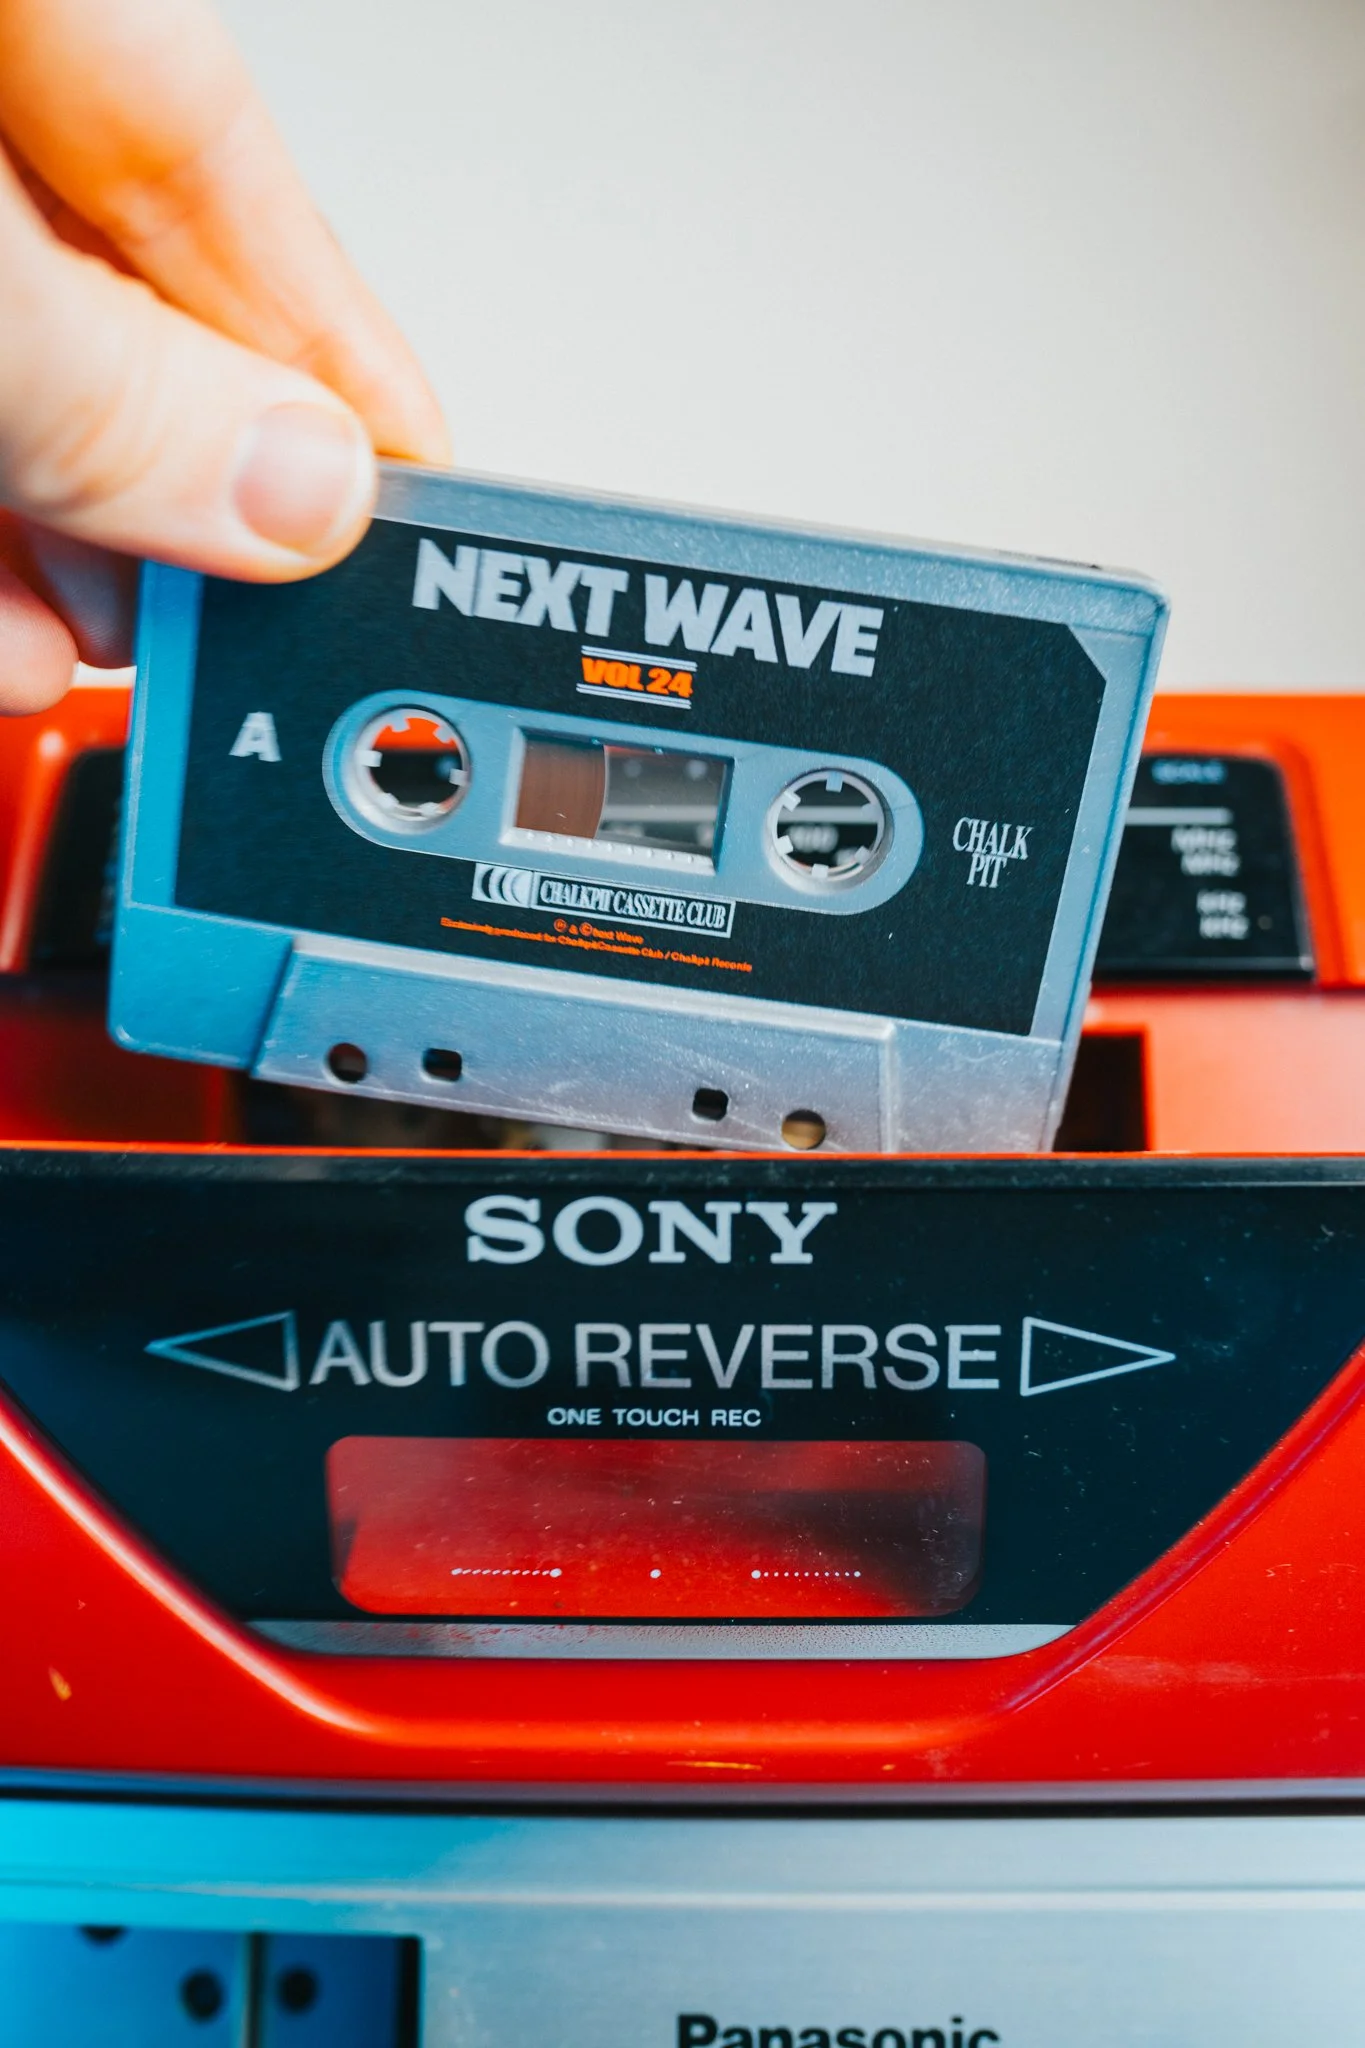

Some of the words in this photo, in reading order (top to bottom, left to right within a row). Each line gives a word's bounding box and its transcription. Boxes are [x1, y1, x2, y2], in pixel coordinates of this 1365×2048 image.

[413, 539, 629, 637] NEXT
[644, 574, 884, 677] WAVE
[581, 657, 645, 692] VOL
[646, 668, 693, 698] 24
[230, 712, 281, 762] A
[952, 816, 1034, 861] CHALK
[966, 852, 1009, 889] PIT
[539, 880, 614, 913] CHALKPIT
[612, 889, 689, 922] CASSETTE
[686, 901, 727, 929] CLUB
[466, 1195, 837, 1266] SONY
[310, 1320, 549, 1388] AUTO
[575, 1323, 1002, 1391] REVERSE
[547, 1407, 602, 1425] ONE
[612, 1408, 699, 1427] TOUCH
[711, 1409, 761, 1427] REC
[676, 2012, 1000, 2048] Panasonic
